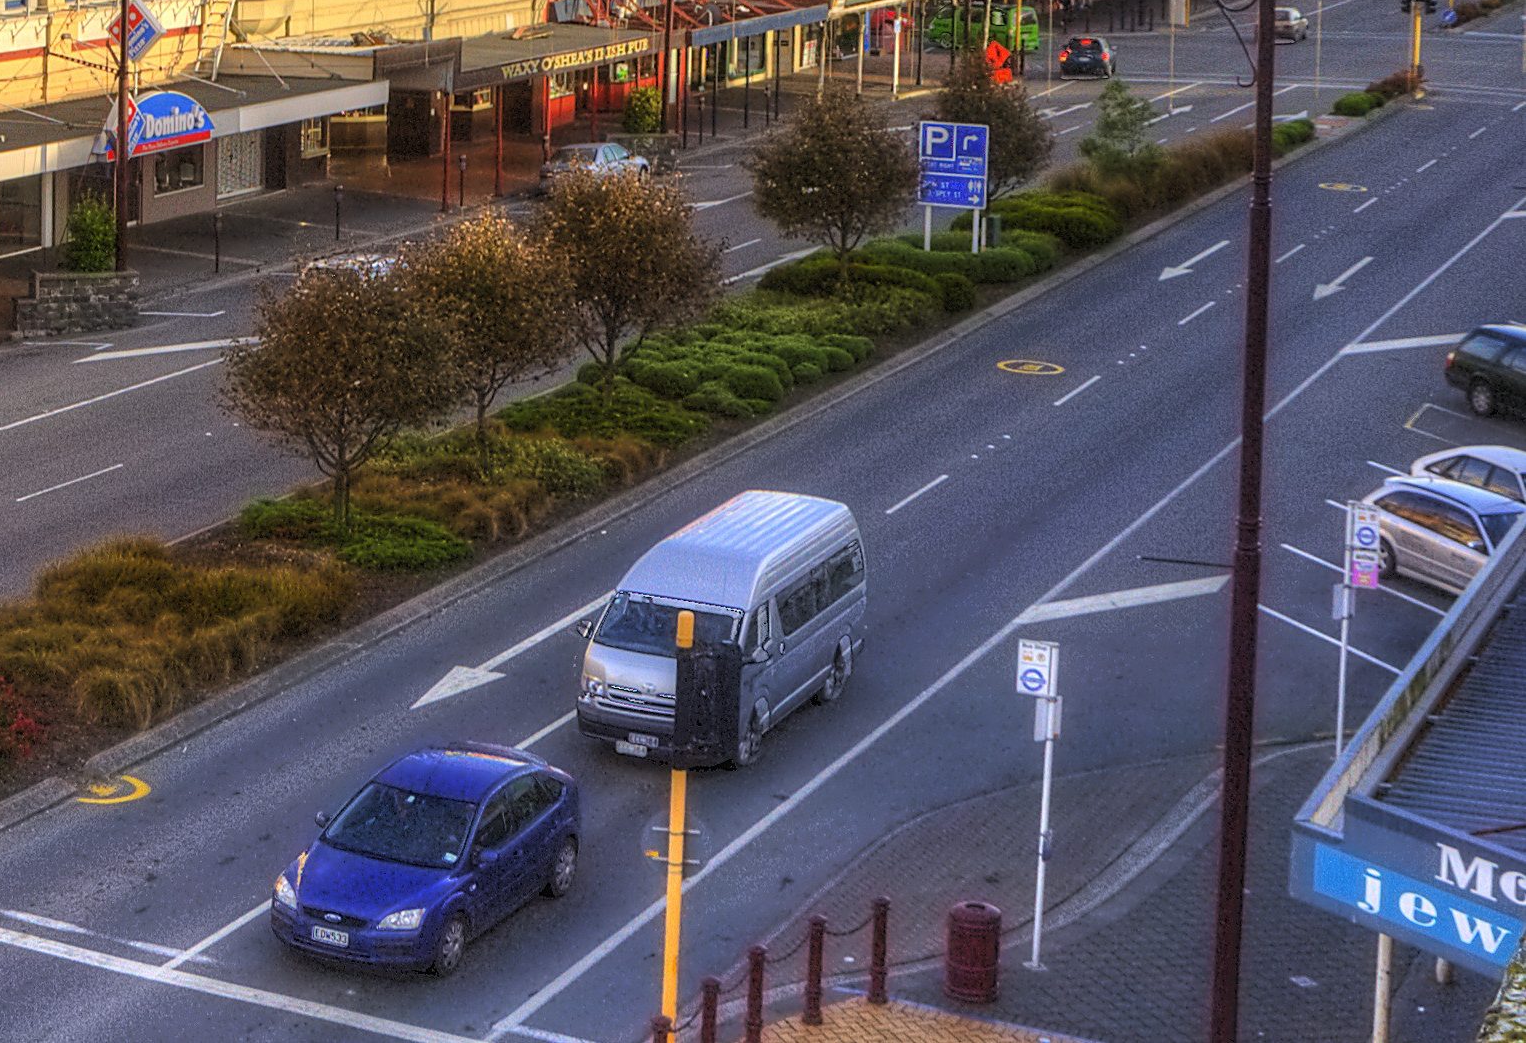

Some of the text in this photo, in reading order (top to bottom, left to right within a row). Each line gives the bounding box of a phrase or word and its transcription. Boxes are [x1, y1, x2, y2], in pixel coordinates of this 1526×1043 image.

[501, 59, 540, 79] WAXY
[541, 48, 593, 71] O'SHEA'S
[628, 38, 649, 54] PUB
[145, 105, 205, 138] Domino's
[926, 126, 950, 156] P
[1356, 867, 1512, 955] jew
